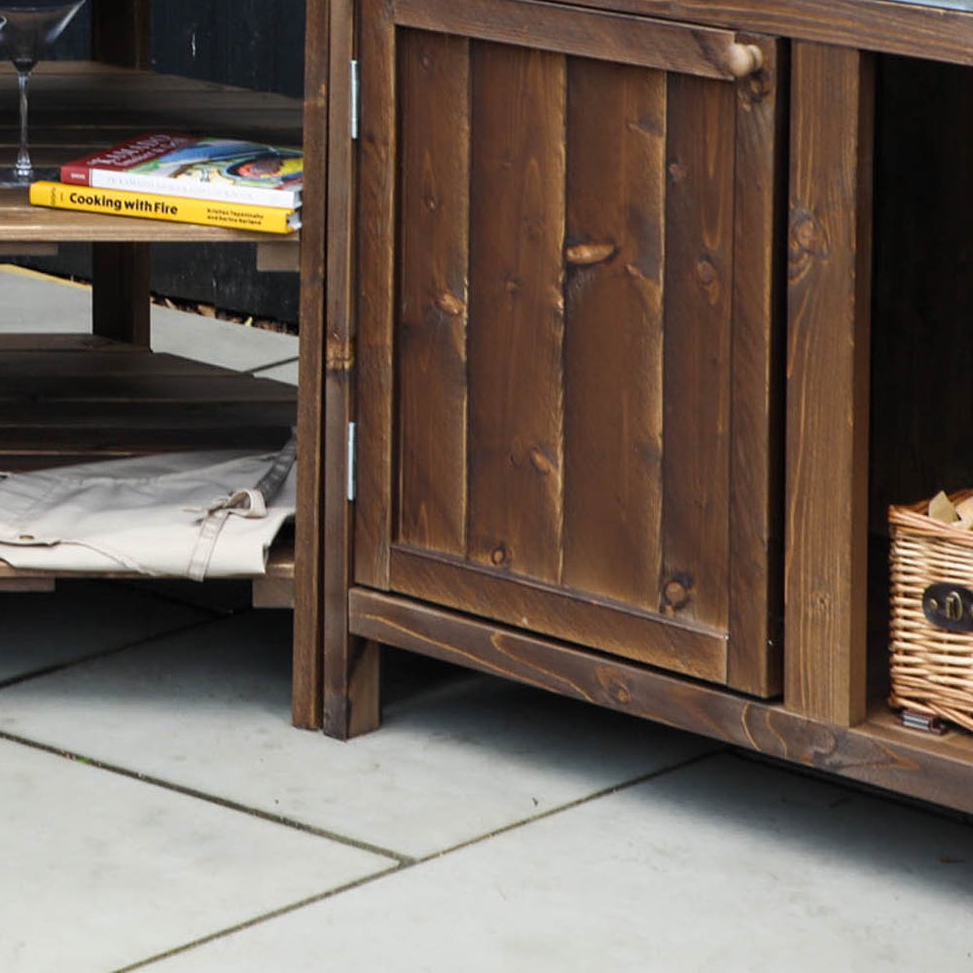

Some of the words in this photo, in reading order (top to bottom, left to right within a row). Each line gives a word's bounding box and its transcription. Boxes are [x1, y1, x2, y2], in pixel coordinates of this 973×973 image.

[69, 192, 122, 211] Cooking
[124, 200, 153, 213] with
[154, 201, 178, 215] Fire
